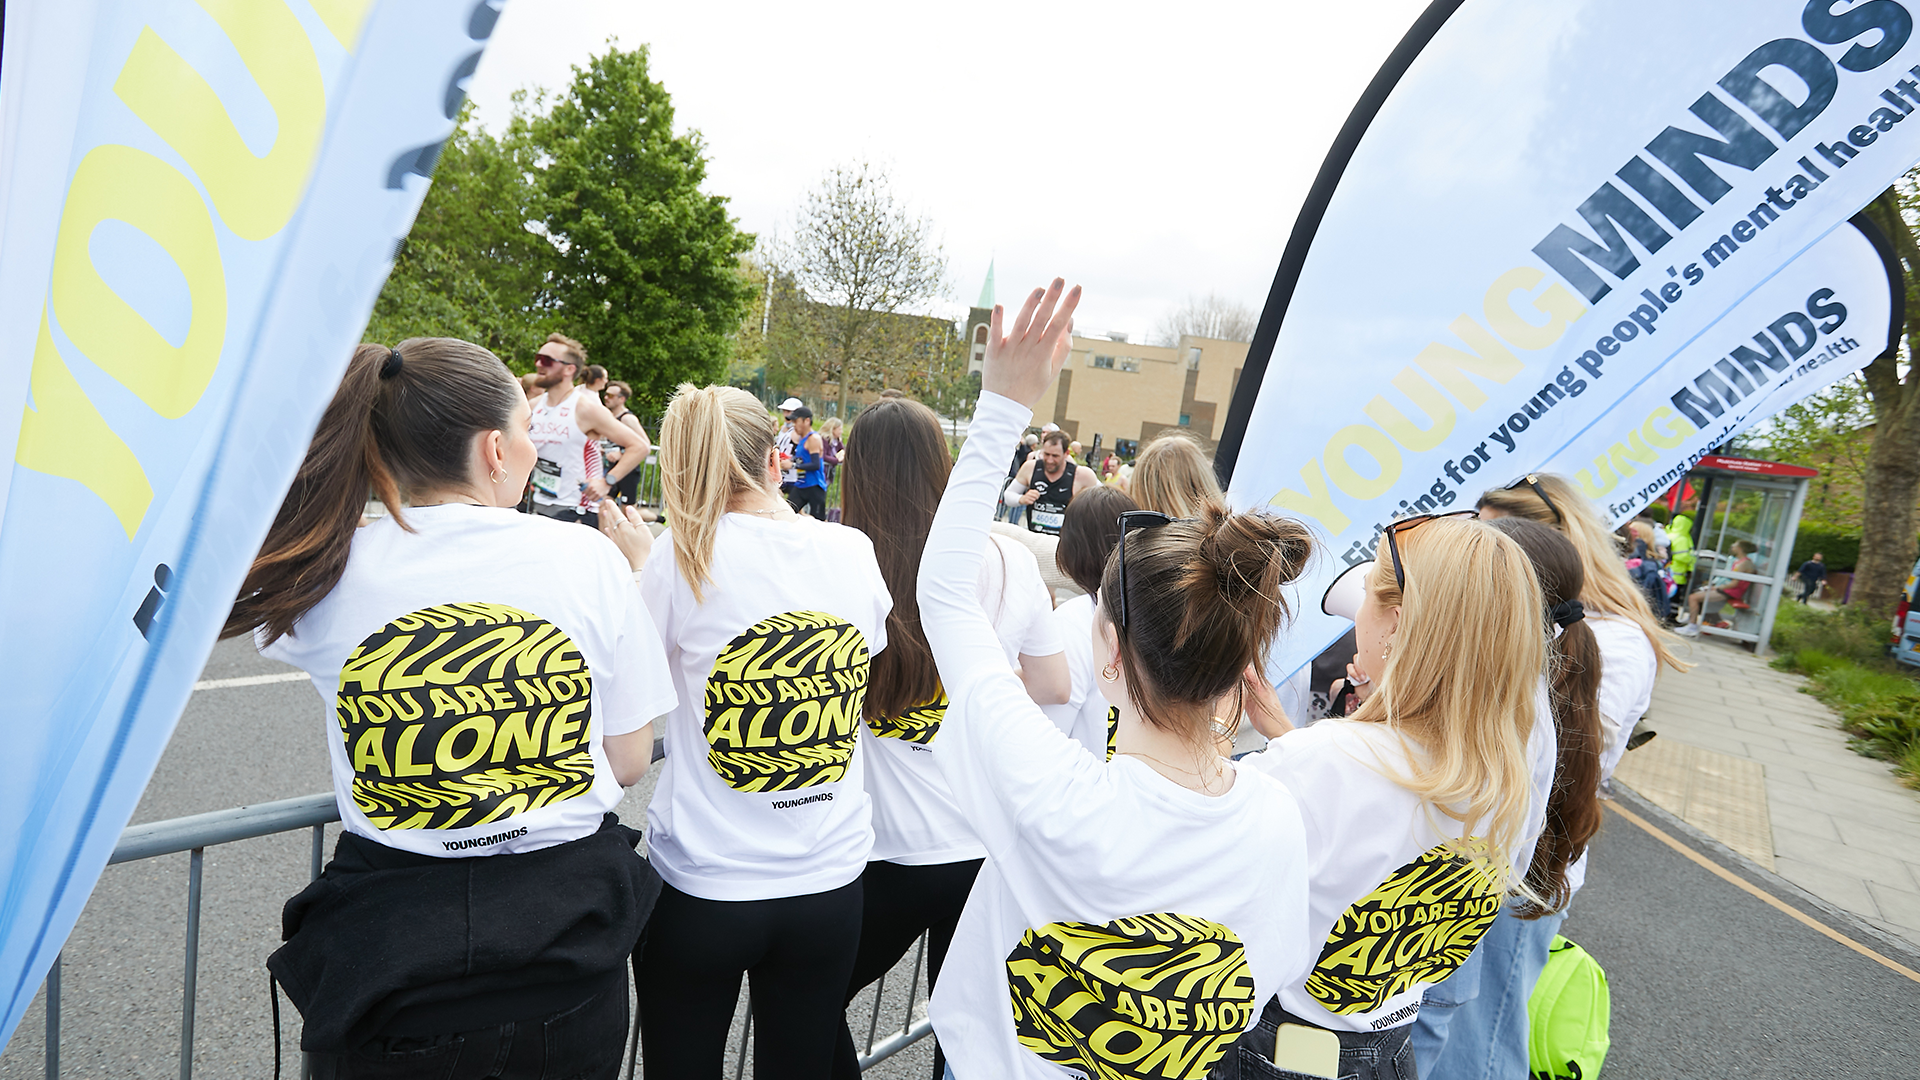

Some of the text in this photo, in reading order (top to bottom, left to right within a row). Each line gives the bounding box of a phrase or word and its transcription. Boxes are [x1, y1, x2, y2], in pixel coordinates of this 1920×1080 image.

[1443, 441, 1492, 485] for
[1488, 365, 1587, 454] young
[1575, 262, 1704, 379] people's
[1702, 155, 1830, 268] mental
[1814, 64, 1920, 169] healt
[532, 421, 569, 439] OLSKA
[1608, 496, 1637, 518] for
[1638, 461, 1688, 504] young
[343, 669, 592, 724] YOU ARE NOT
[707, 680, 773, 705] YOU
[776, 674, 834, 703] ARE
[354, 699, 590, 778] ALONE
[706, 691, 867, 748] ALONE
[771, 792, 833, 810] YOUNGMINDS
[442, 826, 528, 850] YOUNGMINDS
[1354, 896, 1502, 934] YOU ARE NO
[1317, 914, 1497, 976] ALONE
[1111, 990, 1188, 1031] ARE
[1194, 1000, 1255, 1031] NOT
[1370, 1001, 1420, 1030] YOUNGMINDS
